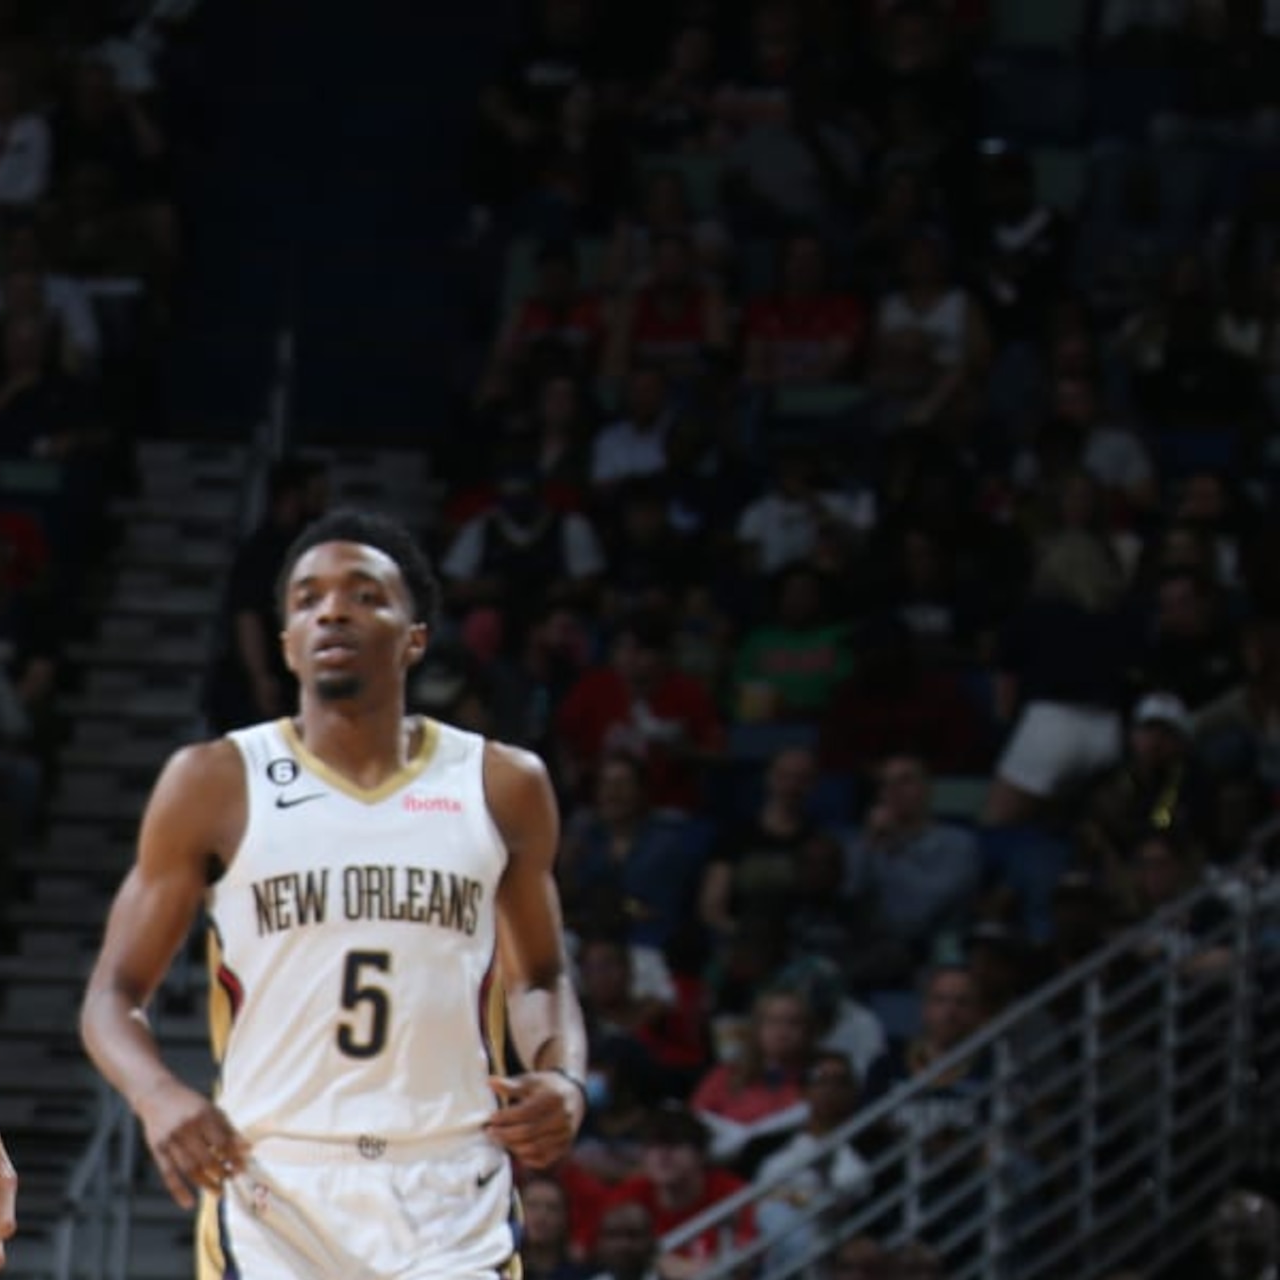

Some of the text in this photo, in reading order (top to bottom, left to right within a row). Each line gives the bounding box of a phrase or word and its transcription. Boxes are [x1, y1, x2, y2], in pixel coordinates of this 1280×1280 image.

[251, 864, 483, 937] NEW ORLEANS
[335, 948, 392, 1060] 5
